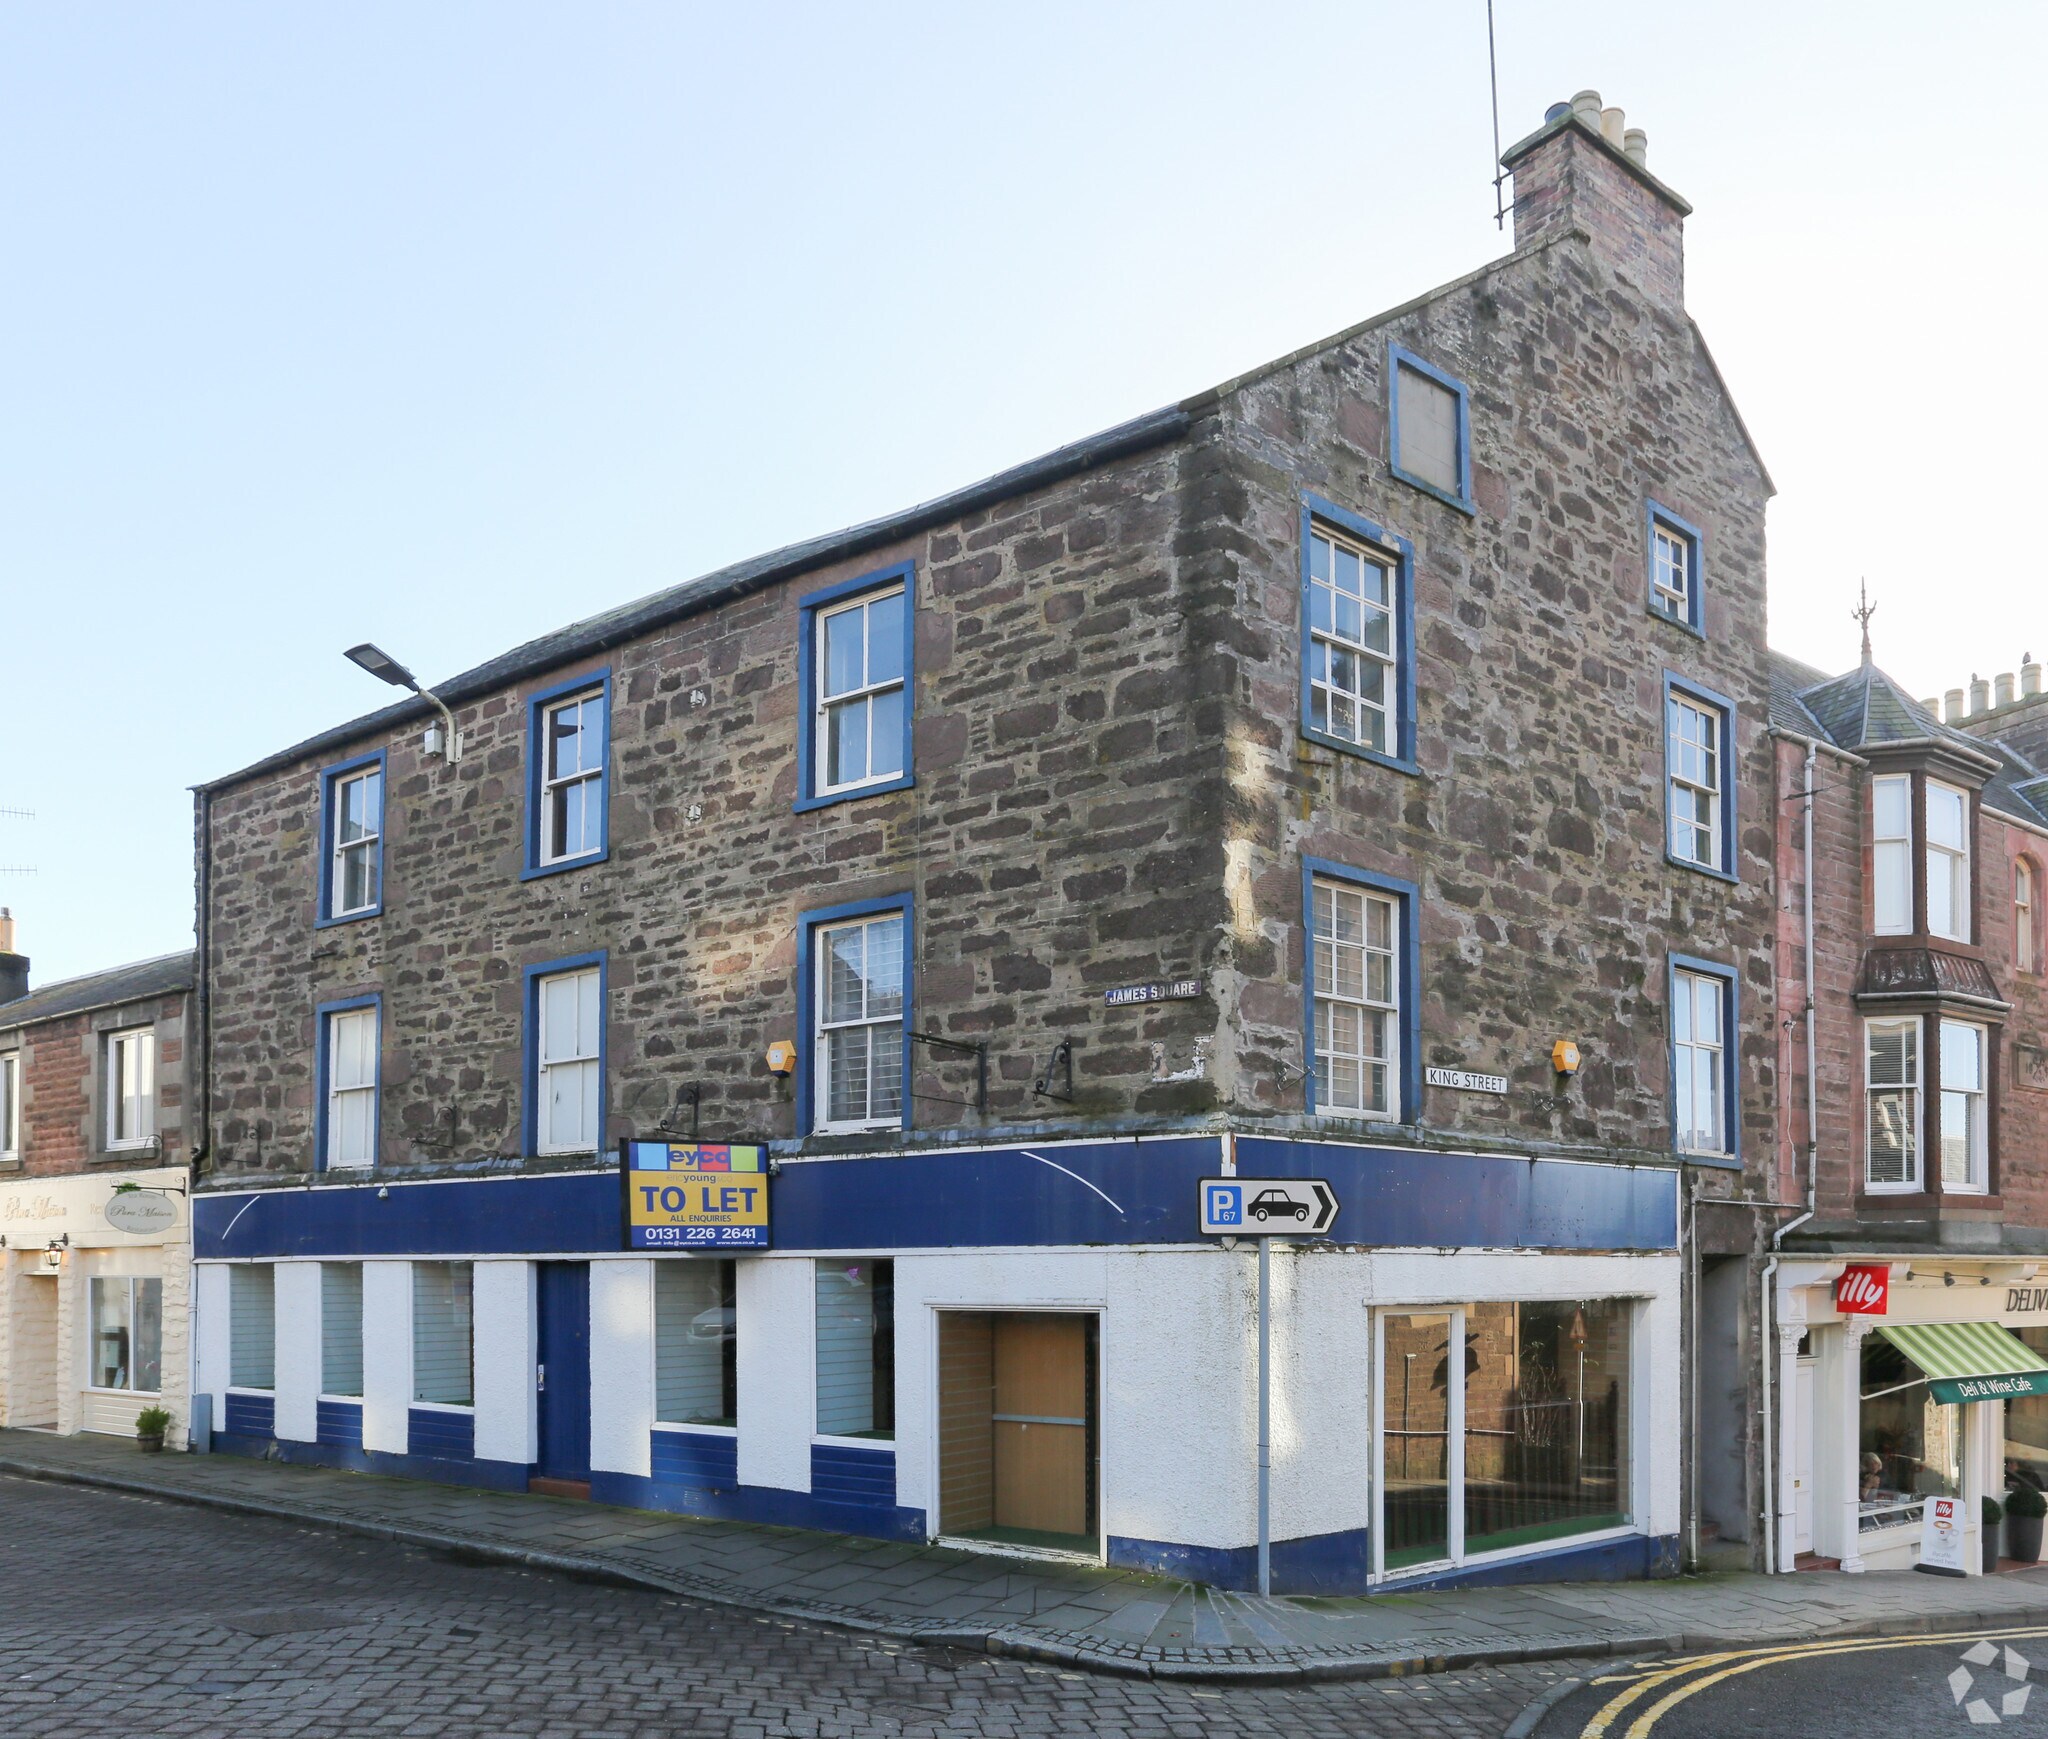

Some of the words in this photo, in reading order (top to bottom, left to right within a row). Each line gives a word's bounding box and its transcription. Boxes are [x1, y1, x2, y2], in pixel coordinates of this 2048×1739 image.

[1109, 987, 1147, 1003] JAMES
[1151, 982, 1196, 998] SQUARE
[1430, 1069, 1459, 1086] KING
[1464, 1073, 1503, 1091] STREET
[669, 1150, 729, 1166] eyco
[640, 1186, 686, 1212] TO
[702, 1187, 757, 1212] LET
[1213, 1191, 1234, 1221] P
[689, 1215, 731, 1223] ENQUIRIES
[1223, 1212, 1236, 1221] 67
[645, 1227, 680, 1239] 0131
[686, 1227, 716, 1239] 226
[722, 1227, 756, 1239] 2641
[1839, 1272, 1884, 1310] illy
[1957, 1381, 1980, 1397] Deli
[1977, 1381, 1990, 1395] &
[1986, 1379, 2013, 1393] Wine
[2010, 1377, 2033, 1391] Cafe
[1936, 1503, 1952, 1517] illy
